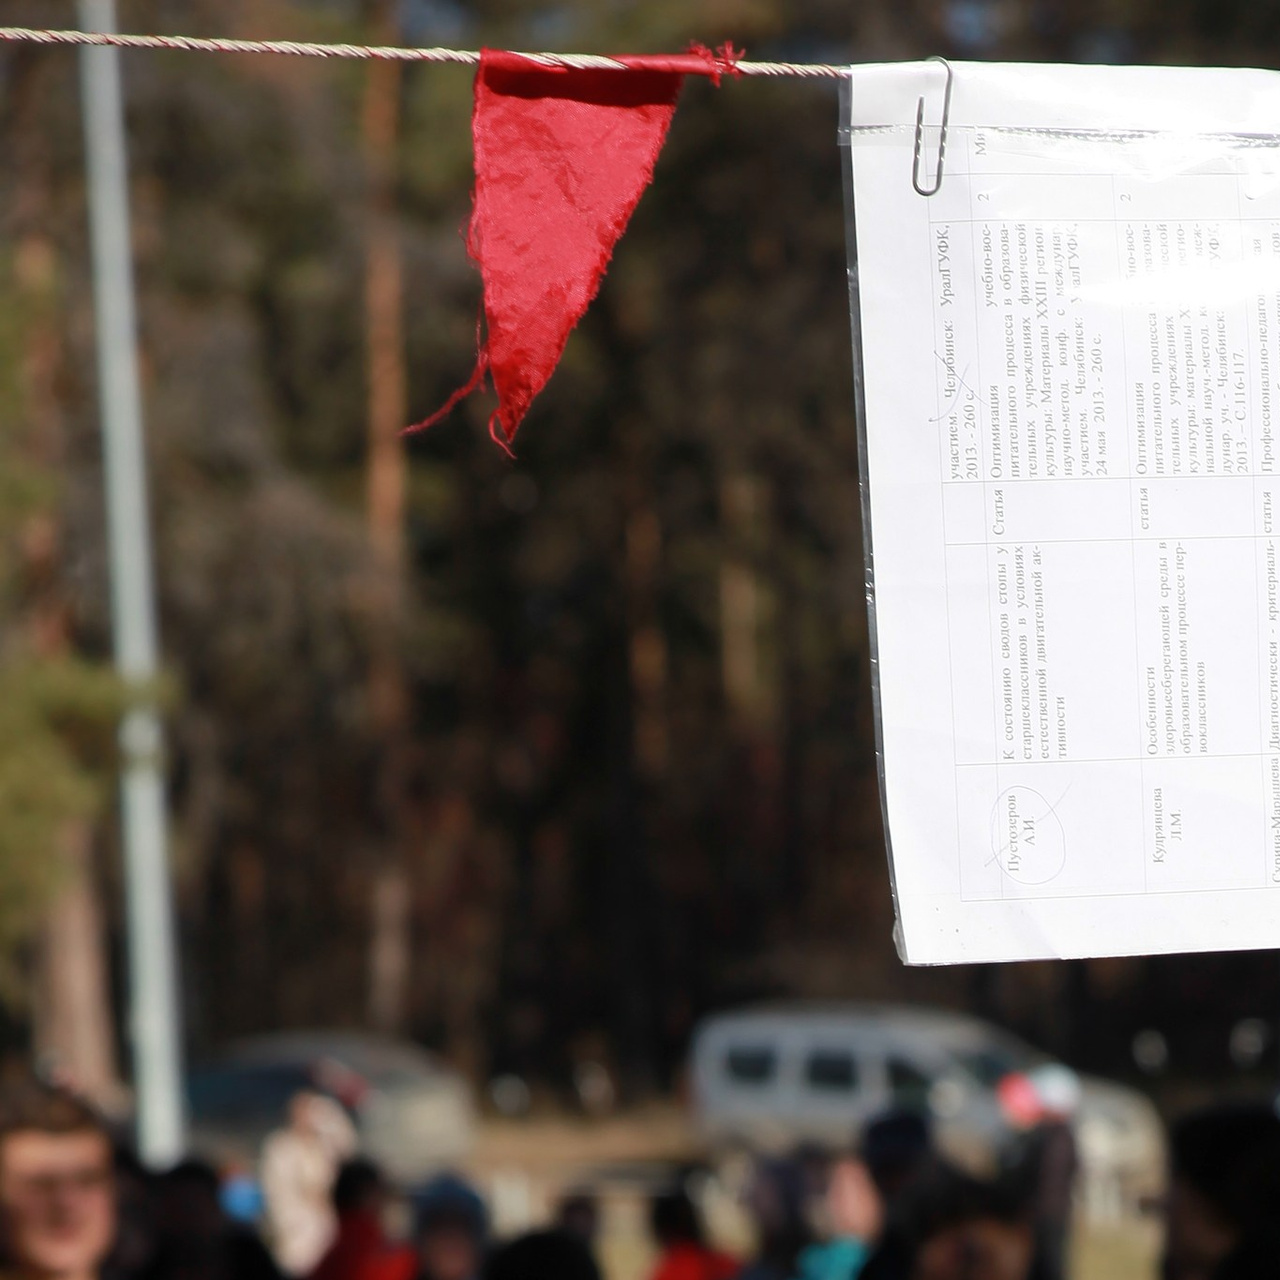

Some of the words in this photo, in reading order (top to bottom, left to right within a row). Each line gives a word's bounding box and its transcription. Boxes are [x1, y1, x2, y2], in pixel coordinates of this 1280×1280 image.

[936, 225, 955, 307] УралГУФК,
[980, 223, 998, 307] учебно-вос-
[998, 223, 1014, 290] образова-
[1014, 223, 1032, 305] физической
[1066, 223, 1082, 304] УалГУФК,
[1034, 281, 1049, 319] XXIII
[941, 320, 958, 398] Челябинск:
[1004, 314, 1018, 377] процесса
[1022, 317, 1037, 408] учреждениях
[1039, 325, 1053, 403] Материалы
[1054, 328, 1069, 366] конф.
[1073, 317, 1086, 395] Челябинск:
[1090, 348, 1103, 373] 260
[1149, 313, 1163, 374] процесса
[1166, 316, 1181, 405] учреждениях
[1183, 325, 1197, 399] материалы
[1200, 325, 1215, 410] науч.-метод.
[1215, 311, 1228, 387] Челябинск:
[962, 404, 976, 429] 260
[1092, 387, 1105, 423] 2013.
[1221, 404, 1232, 424] уч.
[1232, 349, 1246, 421] С.116-117.
[948, 412, 963, 480] участием.
[964, 443, 979, 479] 2013.
[985, 385, 1003, 479] Оптимизация
[1007, 385, 1020, 478] питательного
[1026, 420, 1038, 478] тельных
[1044, 409, 1057, 477] культуры:
[1060, 379, 1074, 476] научно-метод.
[1079, 408, 1092, 476] участием.
[1097, 431, 1107, 455] мая
[1135, 382, 1147, 475] Оптимизация
[1152, 382, 1165, 474] питательного
[1170, 417, 1181, 475] тельных
[1187, 405, 1200, 473] культуры:
[1201, 417, 1215, 473] нальной
[1222, 429, 1234, 474] дунар.
[1235, 437, 1249, 473] 2013.
[992, 489, 1005, 536] Статья
[1139, 487, 1150, 530] статья
[1263, 491, 1272, 534] статья
[997, 563, 1008, 605] стопы
[1014, 546, 1029, 608] условиях
[1032, 545, 1042, 565] ак-
[1159, 557, 1172, 598] среды
[1175, 541, 1187, 570] пер-
[1266, 540, 1279, 621] критериаль-
[1000, 613, 1011, 659] сводов
[1030, 571, 1048, 663] двигательной
[1177, 574, 1190, 635] процессе
[1002, 667, 1014, 741] состоянию
[1018, 634, 1035, 760] старшеклассников
[1035, 668, 1050, 759] естественной
[1145, 667, 1158, 755] Особенности
[1158, 605, 1177, 755] здоровьесберегающей
[1178, 639, 1194, 754] образовательном
[1196, 661, 1208, 753] воклассников
[1056, 696, 1067, 759] тивности
[1007, 794, 1022, 871] Пустозеров
[1022, 816, 1035, 846] А.И.
[1152, 787, 1167, 863] Кудрявцева
[1169, 809, 1182, 841] Л.М.
